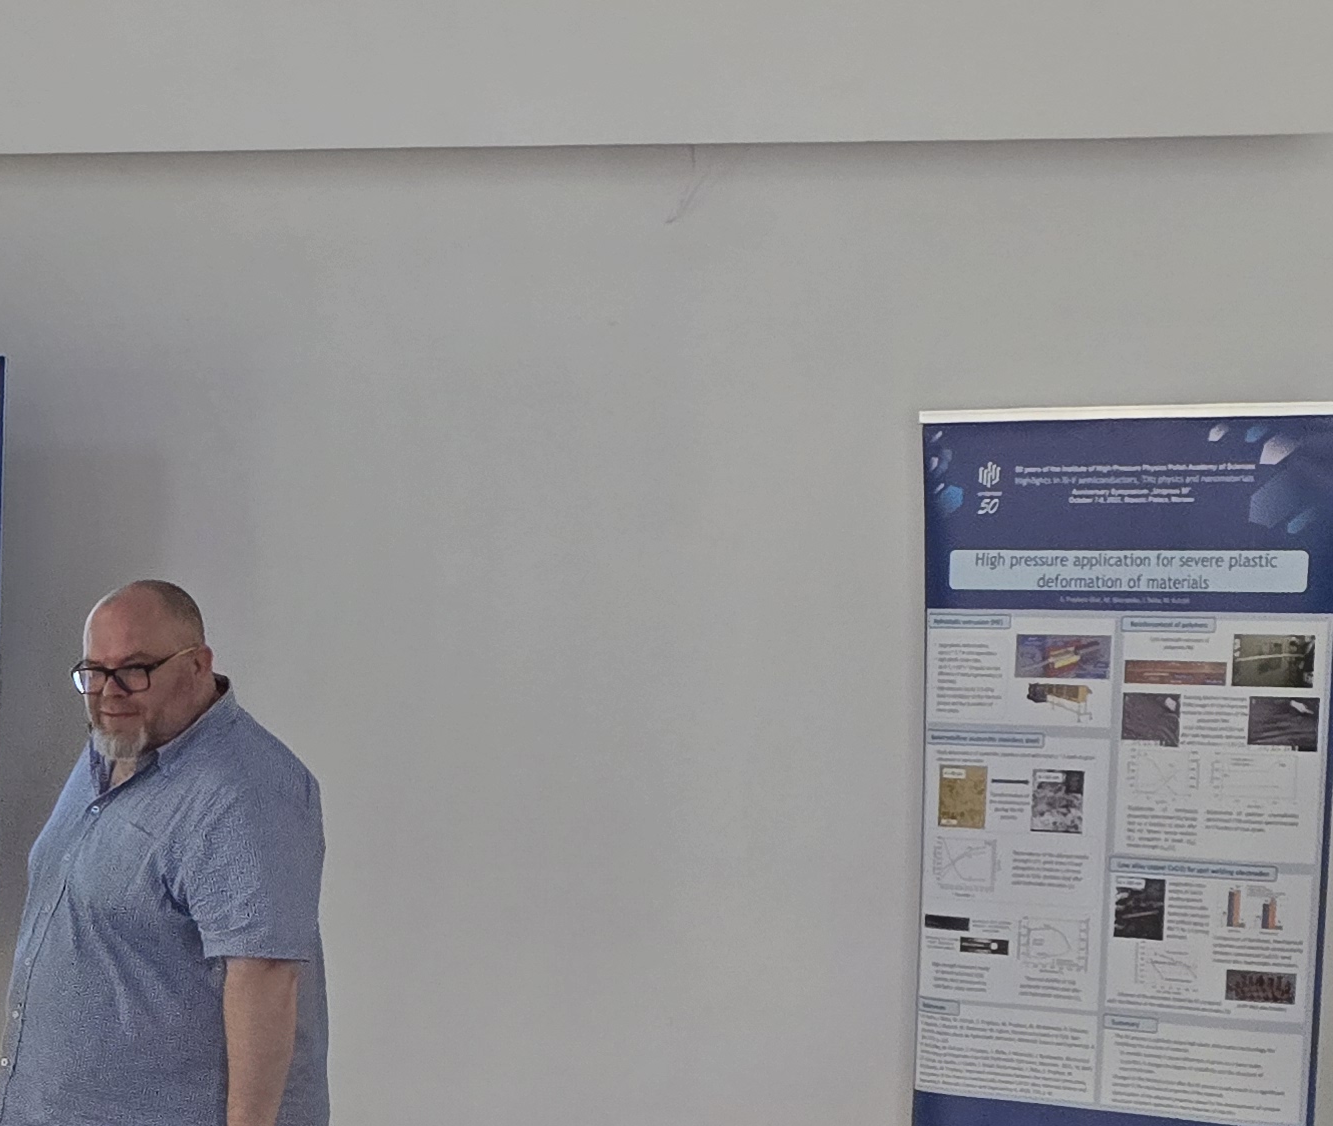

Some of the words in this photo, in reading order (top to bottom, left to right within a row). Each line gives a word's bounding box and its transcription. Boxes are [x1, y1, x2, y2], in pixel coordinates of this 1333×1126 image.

[977, 498, 1000, 515] 50
[974, 552, 1006, 569] High
[1010, 554, 1069, 569] pressure
[1073, 552, 1151, 570] application
[1155, 553, 1176, 568] for
[1179, 555, 1224, 568] severe
[1228, 552, 1278, 570] plastic
[1036, 574, 1122, 590] deformation
[1127, 574, 1142, 590] of
[1146, 575, 1210, 590] materials
